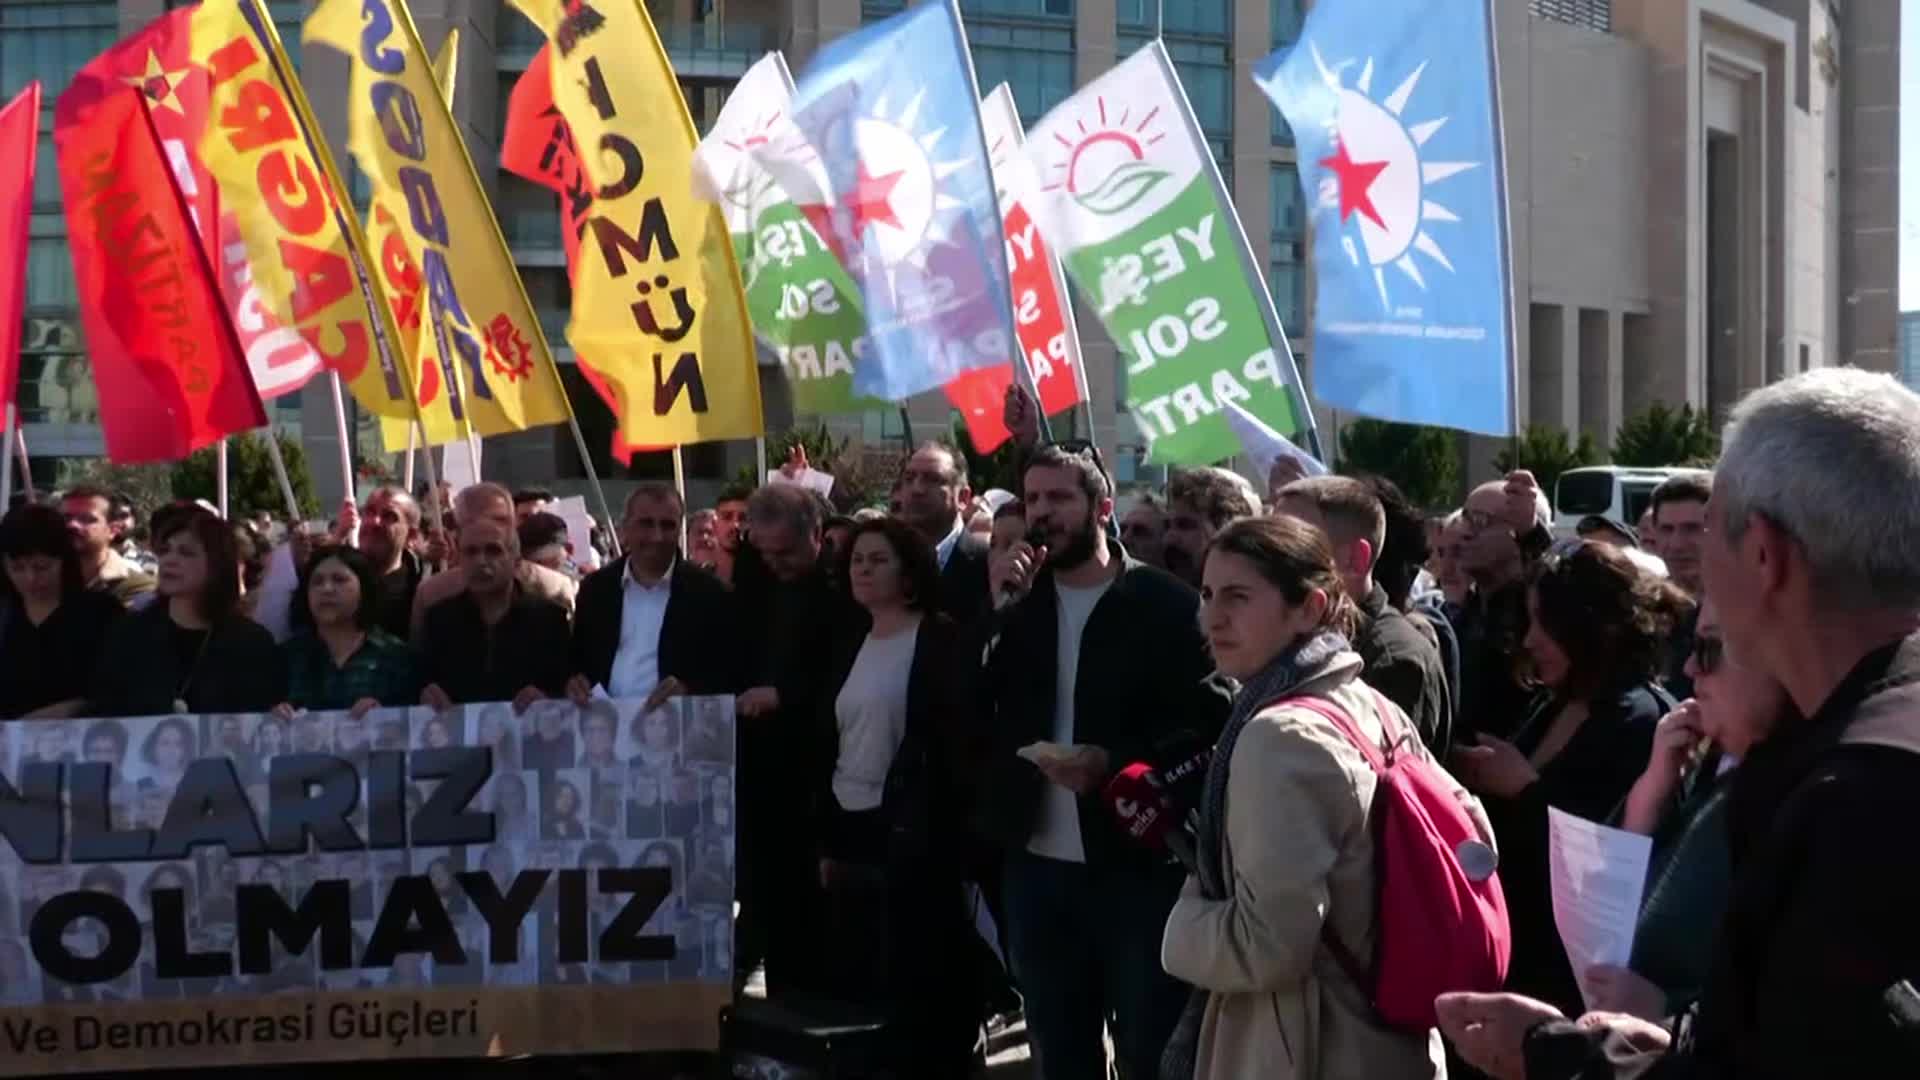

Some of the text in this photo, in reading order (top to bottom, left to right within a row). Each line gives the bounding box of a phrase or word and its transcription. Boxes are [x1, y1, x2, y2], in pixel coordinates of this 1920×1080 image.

[29, 867, 677, 984] OLMAYIZ
[3, 1001, 478, 1055] Ve Demokrasi Güçleri
